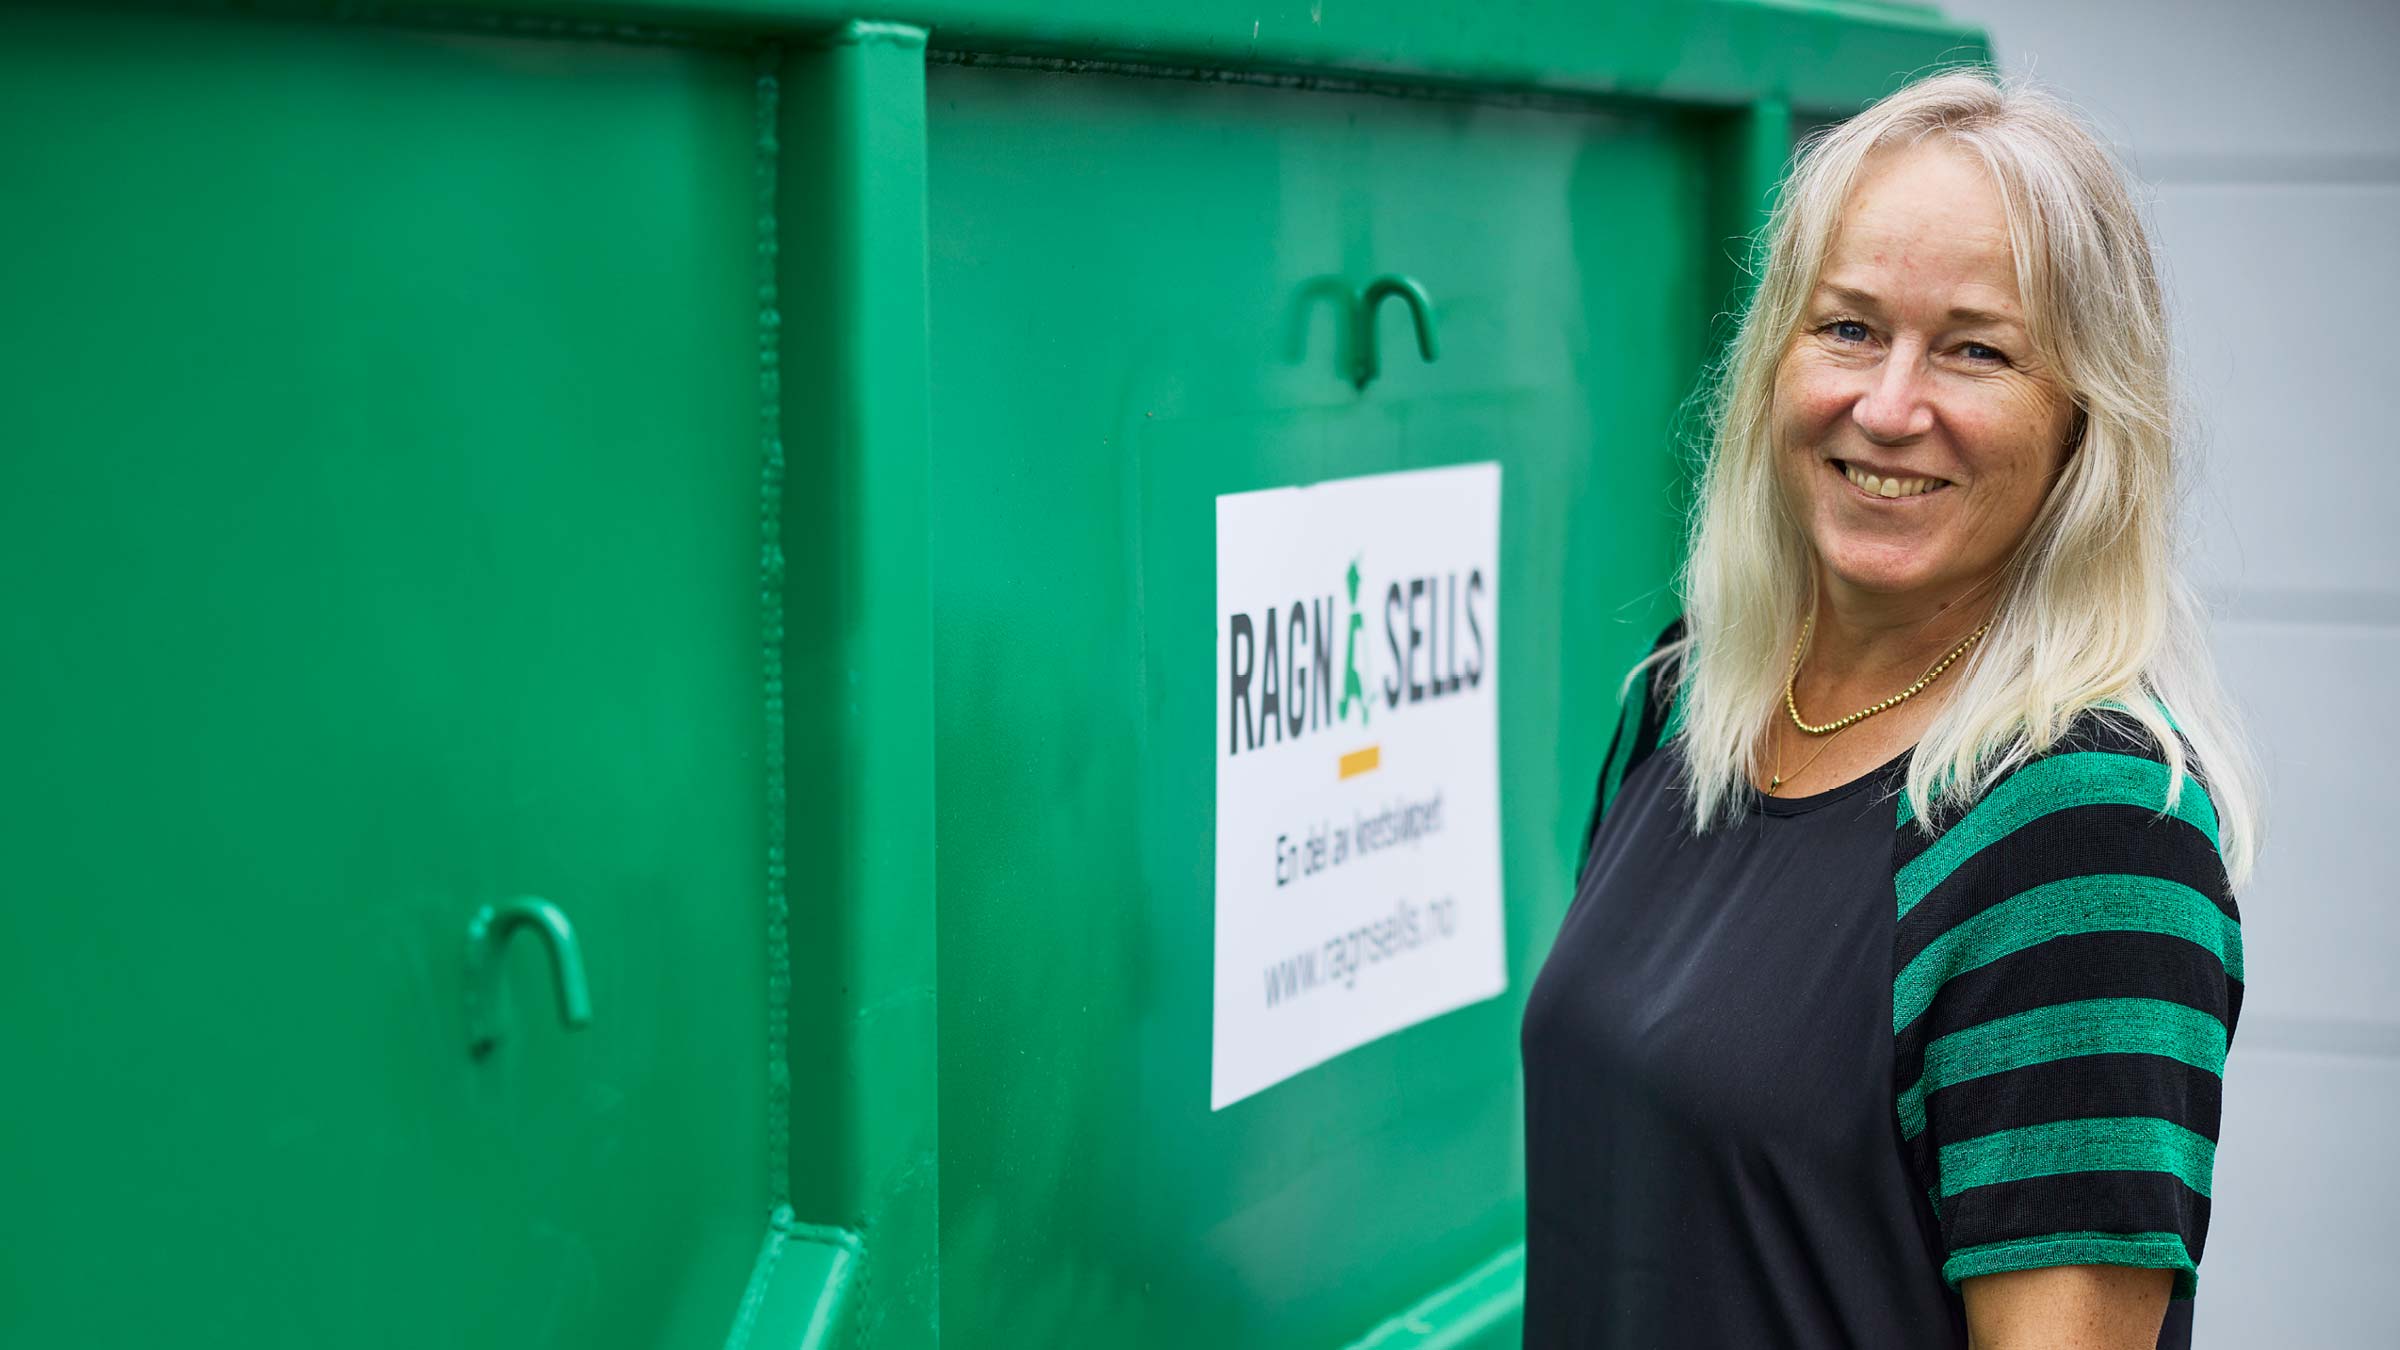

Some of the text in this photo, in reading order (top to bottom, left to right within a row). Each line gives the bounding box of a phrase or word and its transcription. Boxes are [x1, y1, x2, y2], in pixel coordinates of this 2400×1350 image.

[1384, 569, 1485, 709] SELLS
[1276, 834, 1298, 887] En
[1304, 821, 1328, 876] del
[1333, 828, 1350, 866] av
[1264, 895, 1457, 1009] www.ragnsells.no
